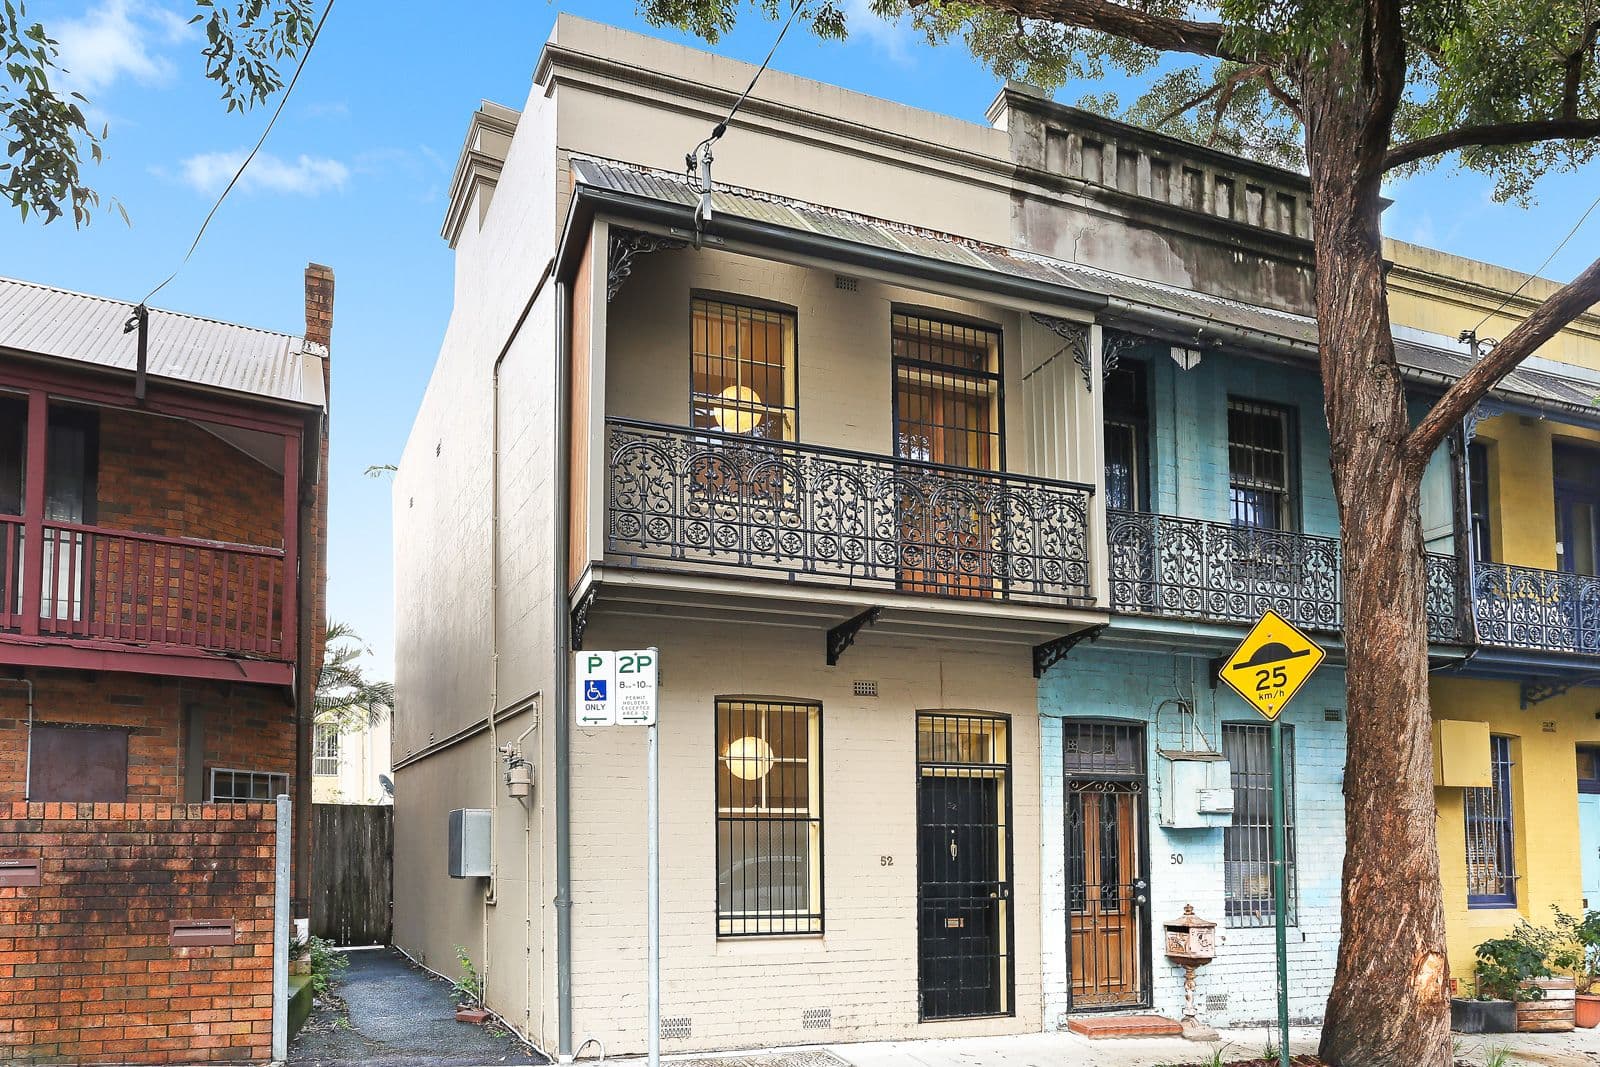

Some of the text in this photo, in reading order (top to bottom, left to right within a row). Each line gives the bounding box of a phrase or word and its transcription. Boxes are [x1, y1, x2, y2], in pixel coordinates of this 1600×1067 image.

[588, 656, 603, 674] P
[618, 655, 652, 673] 2P
[1255, 665, 1288, 692] 25
[1258, 689, 1285, 701] km/h
[585, 703, 606, 711] ONLY
[880, 855, 894, 867] 52
[1170, 853, 1184, 865] 50
